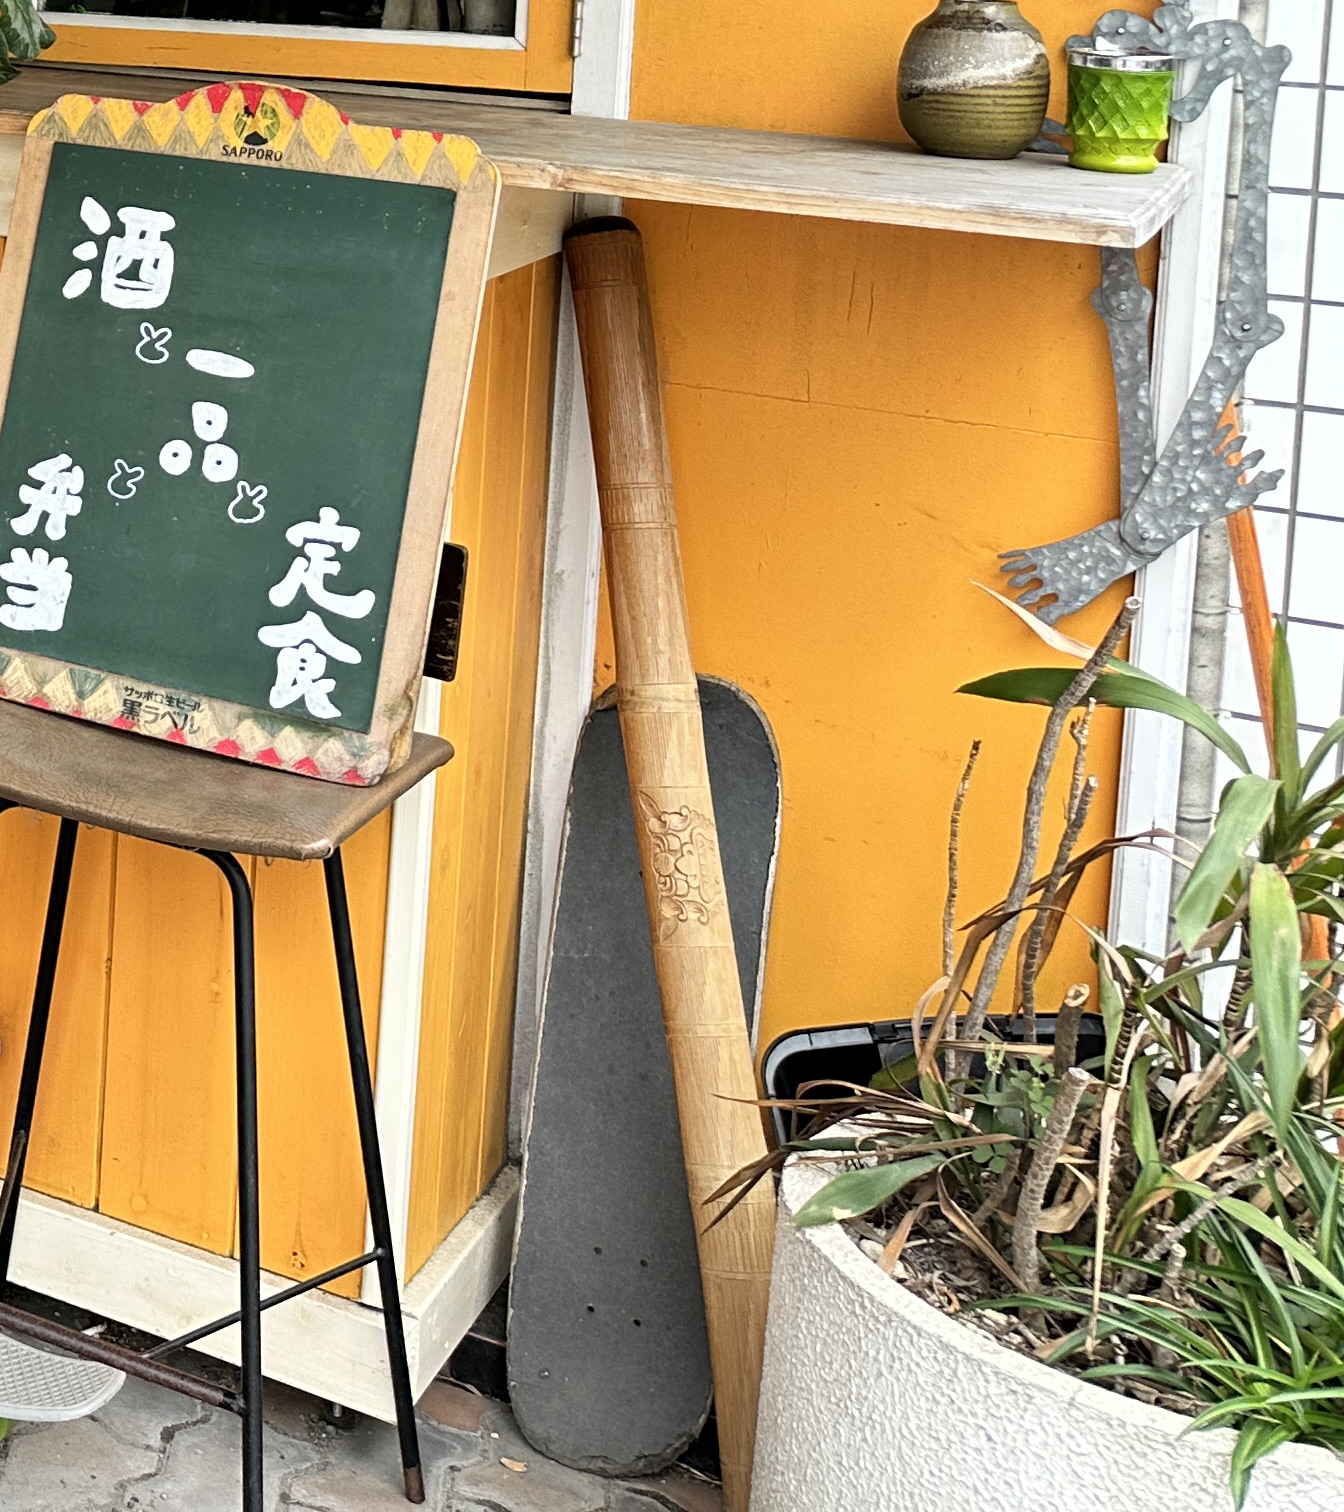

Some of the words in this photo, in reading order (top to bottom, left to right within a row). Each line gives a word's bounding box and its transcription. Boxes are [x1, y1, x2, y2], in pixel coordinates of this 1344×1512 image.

[221, 144, 283, 162] SAPPORO
[62, 195, 176, 309] 酒
[159, 347, 255, 483] 一品
[258, 506, 376, 720] 定食
[121, 698, 202, 735] 黒ラベル
[123, 685, 205, 713] サッポロ生ビール
